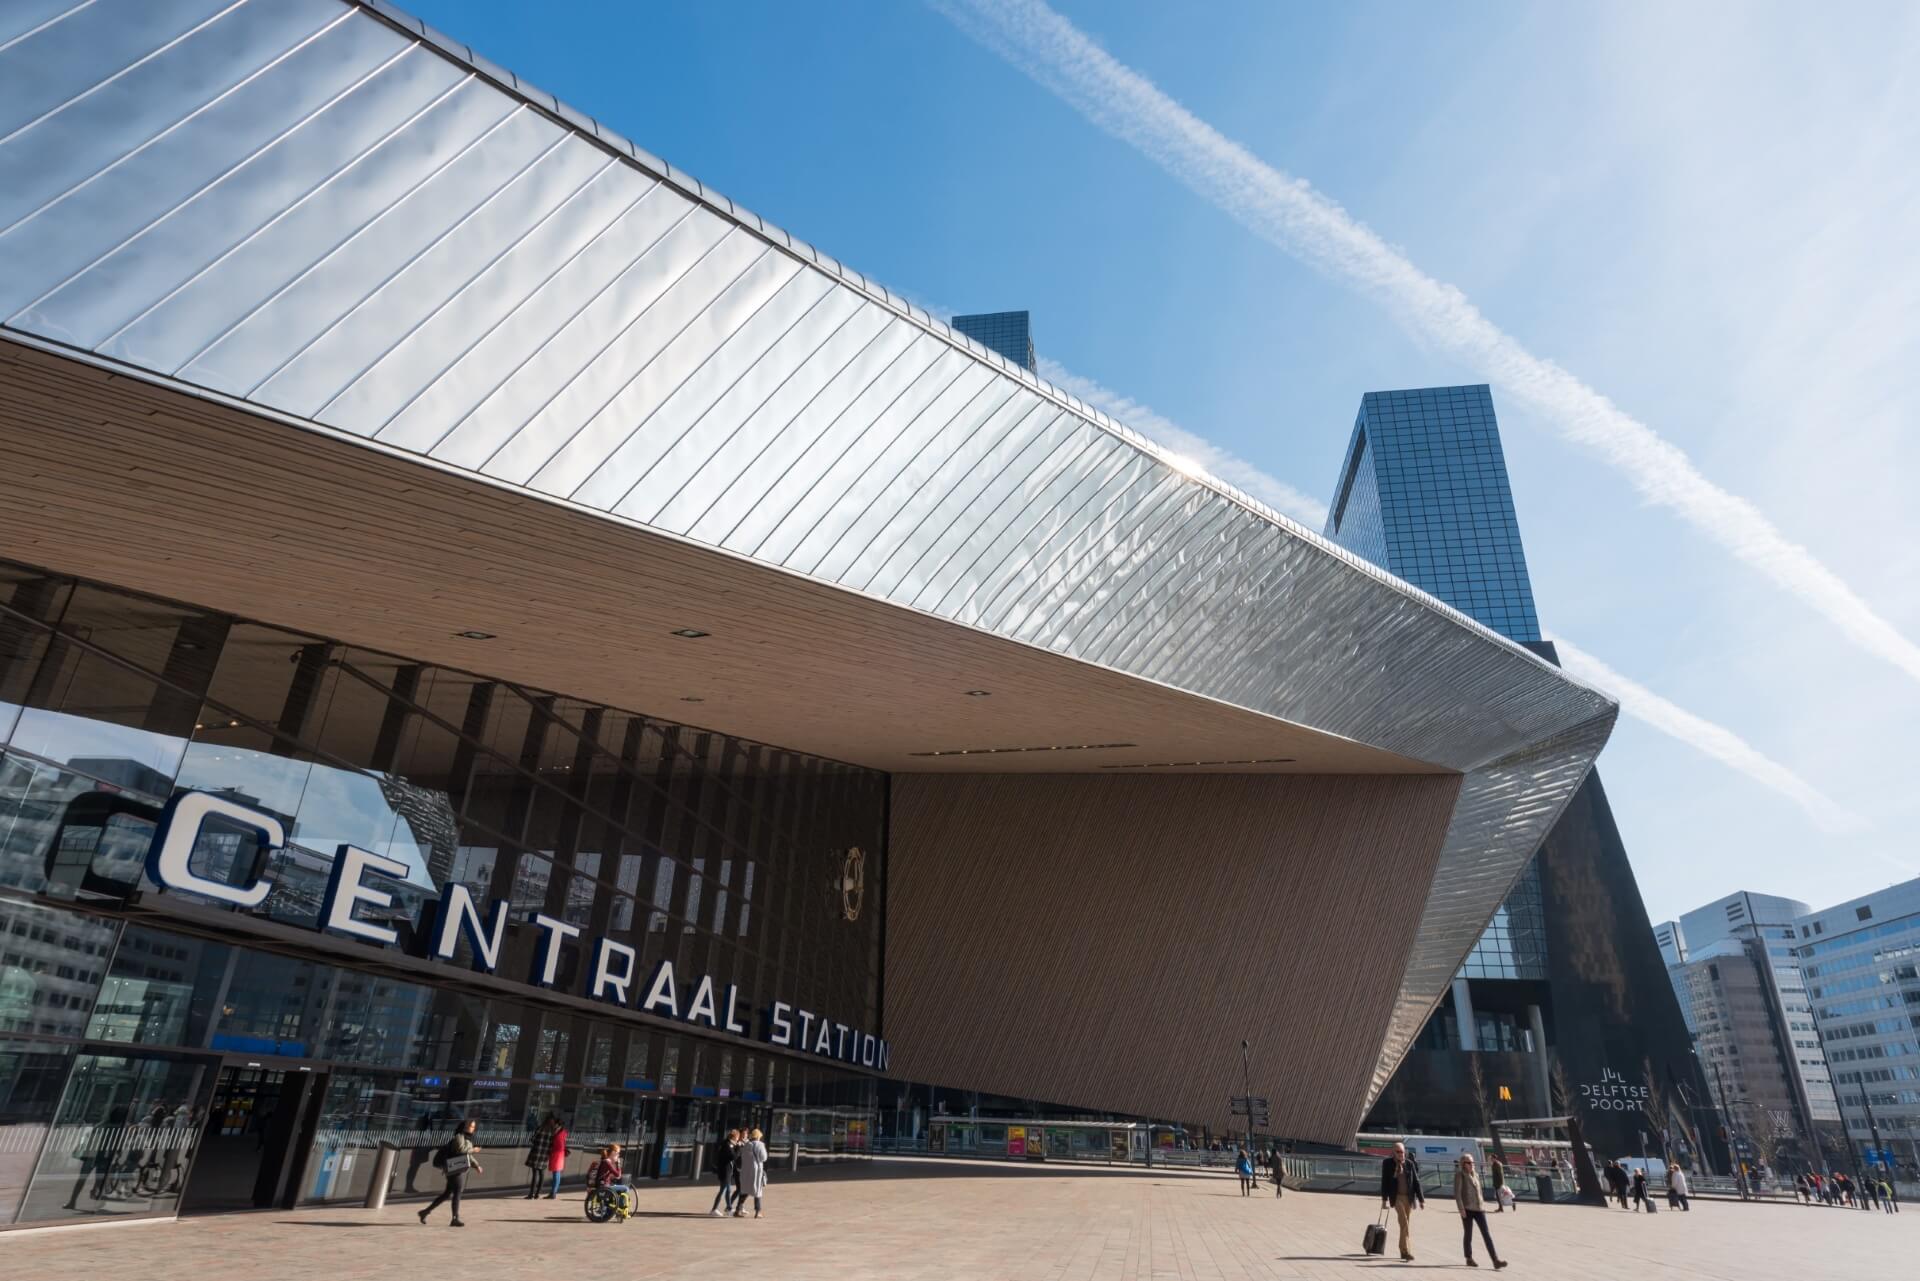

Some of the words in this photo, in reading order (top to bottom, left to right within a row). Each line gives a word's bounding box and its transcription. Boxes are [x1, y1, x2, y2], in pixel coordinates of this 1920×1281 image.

[147, 789, 745, 1034] CENTRAAL
[769, 1001, 890, 1072] STATION
[1580, 1084, 1649, 1098] DELFTSE
[1590, 1099, 1644, 1111] POORT
